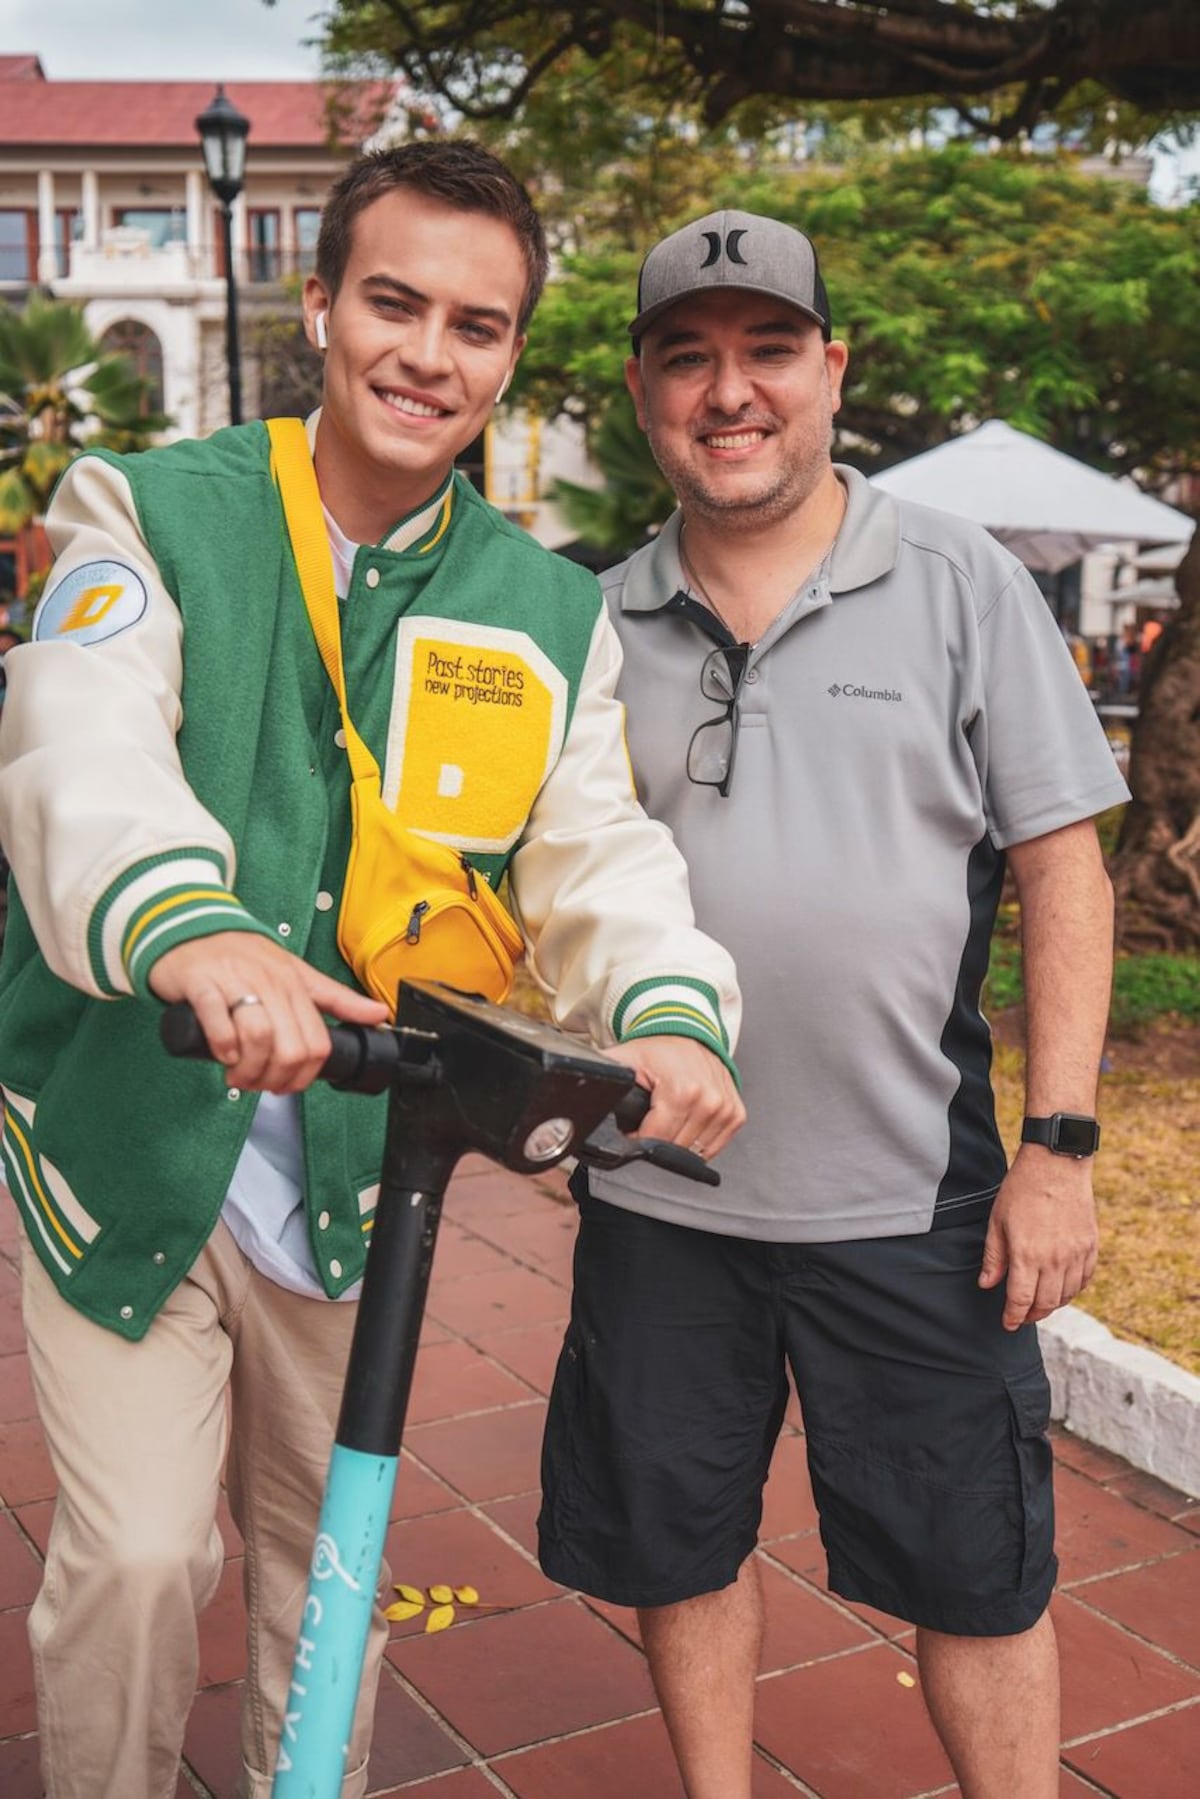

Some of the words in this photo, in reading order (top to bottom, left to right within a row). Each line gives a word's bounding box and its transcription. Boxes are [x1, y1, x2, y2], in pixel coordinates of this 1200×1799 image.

[427, 651, 463, 680] Past
[466, 659, 524, 690] stories
[424, 679, 450, 695] new
[453, 683, 523, 707] projections
[842, 683, 902, 701] Columbia
